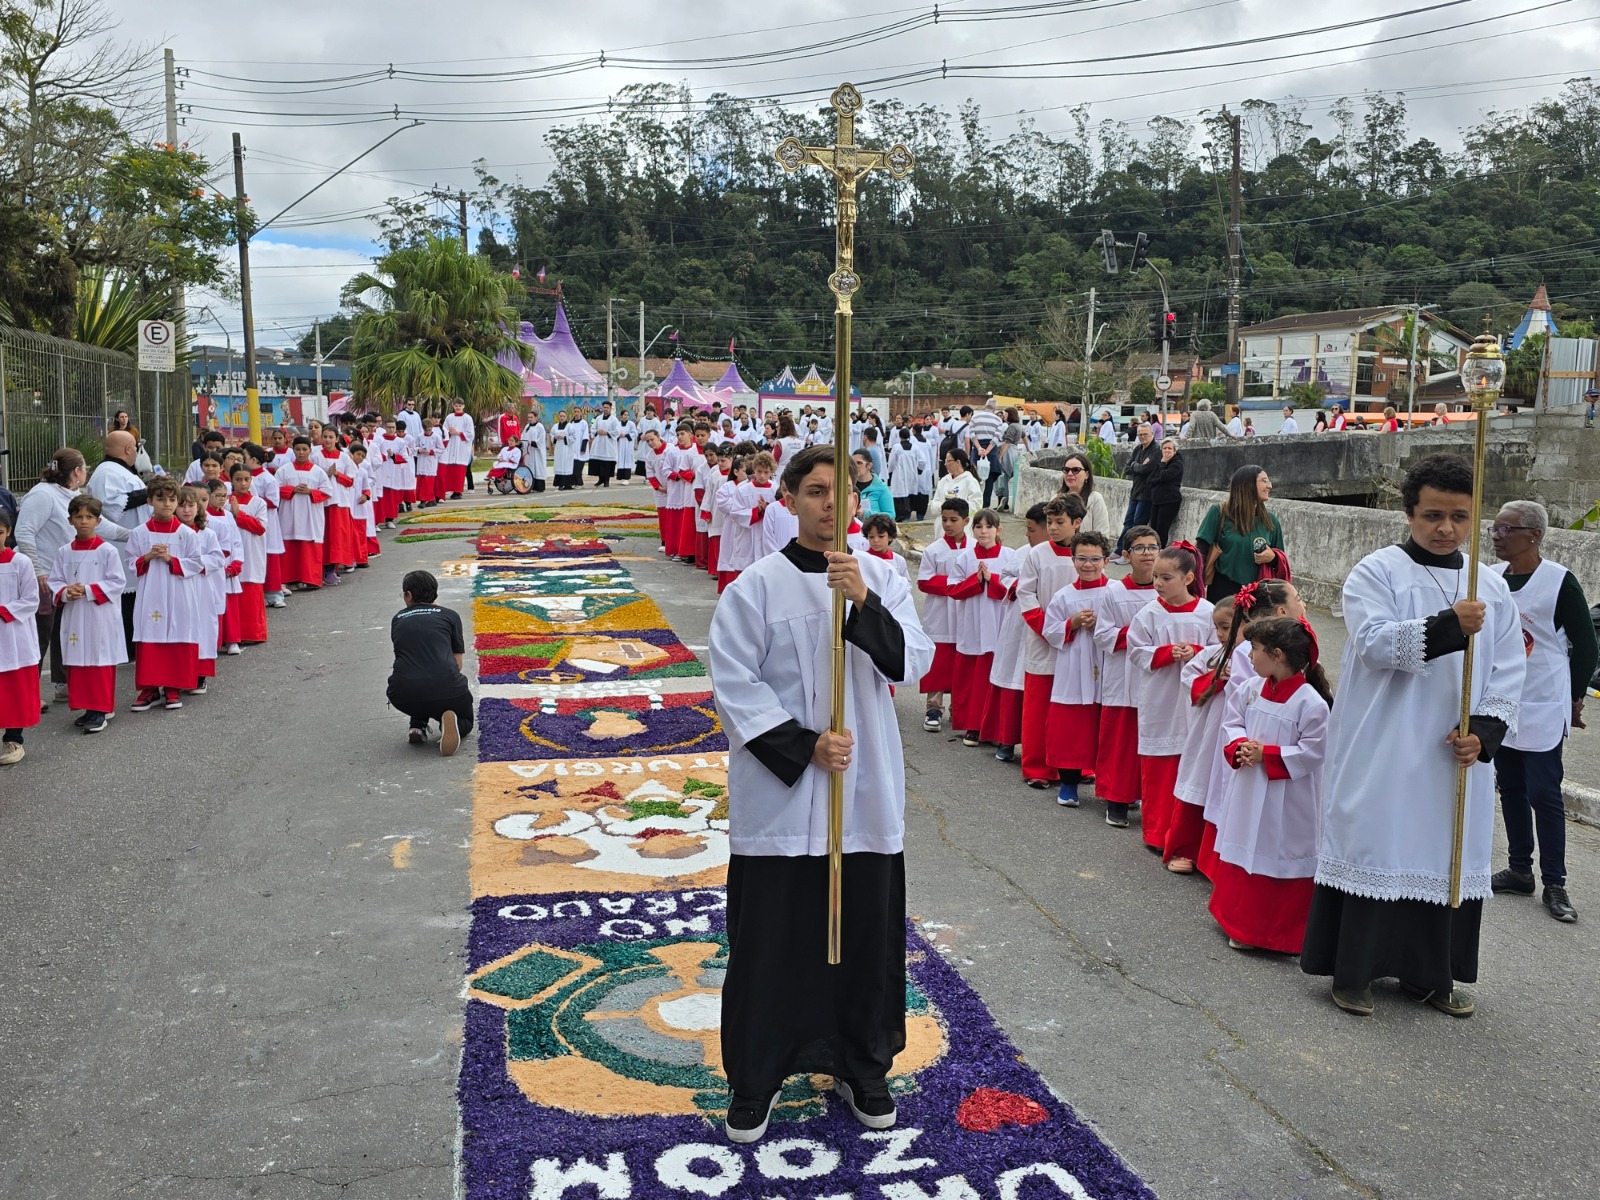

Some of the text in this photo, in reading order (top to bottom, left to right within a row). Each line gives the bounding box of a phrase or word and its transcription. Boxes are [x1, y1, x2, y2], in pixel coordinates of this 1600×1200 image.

[151, 326, 162, 340] E
[215, 380, 277, 396] MILER
[223, 411, 273, 427] MILER
[508, 756, 729, 778] ITURGIA
[528, 1128, 936, 1200] ZOOM
